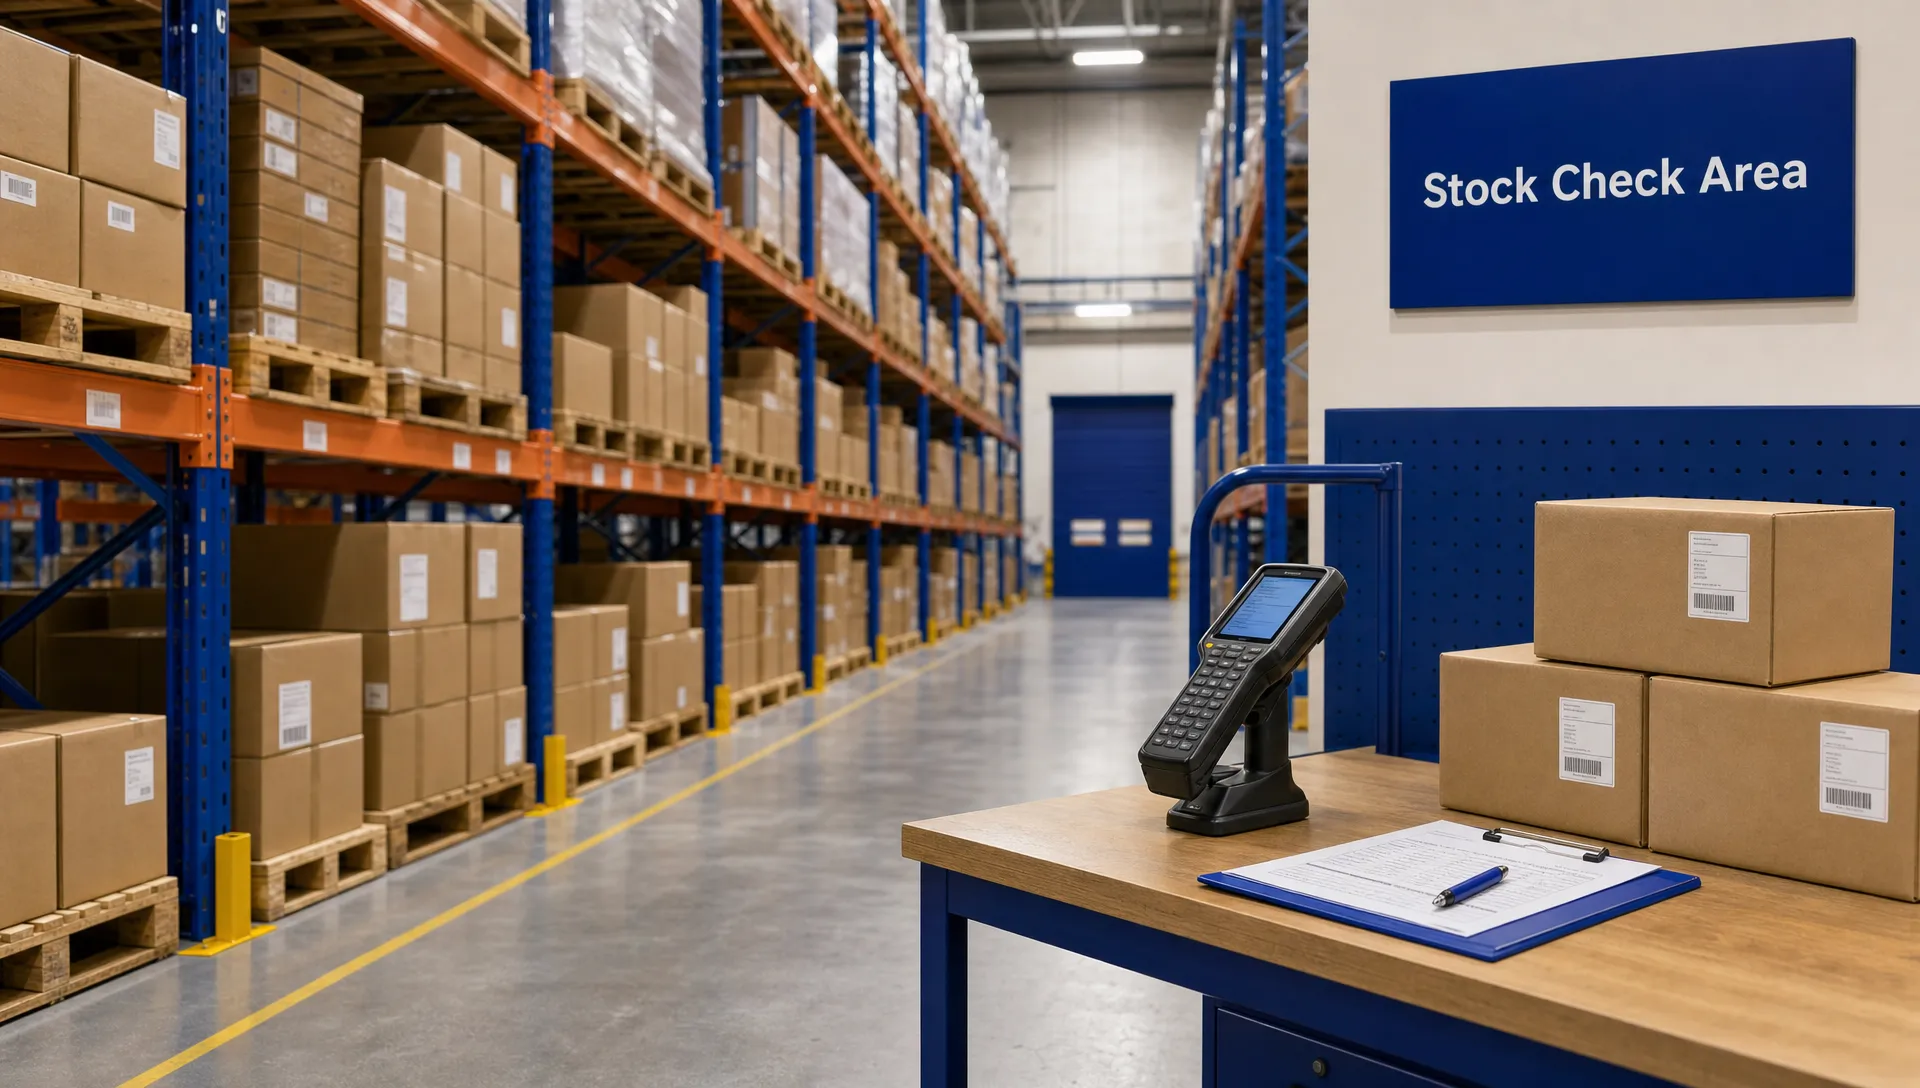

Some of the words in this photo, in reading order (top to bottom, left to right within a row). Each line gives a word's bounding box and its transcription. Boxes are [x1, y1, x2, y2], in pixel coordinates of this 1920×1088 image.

[1423, 166, 1539, 209] Stock
[1552, 157, 1686, 202] Check
[1699, 155, 1808, 194] Area
